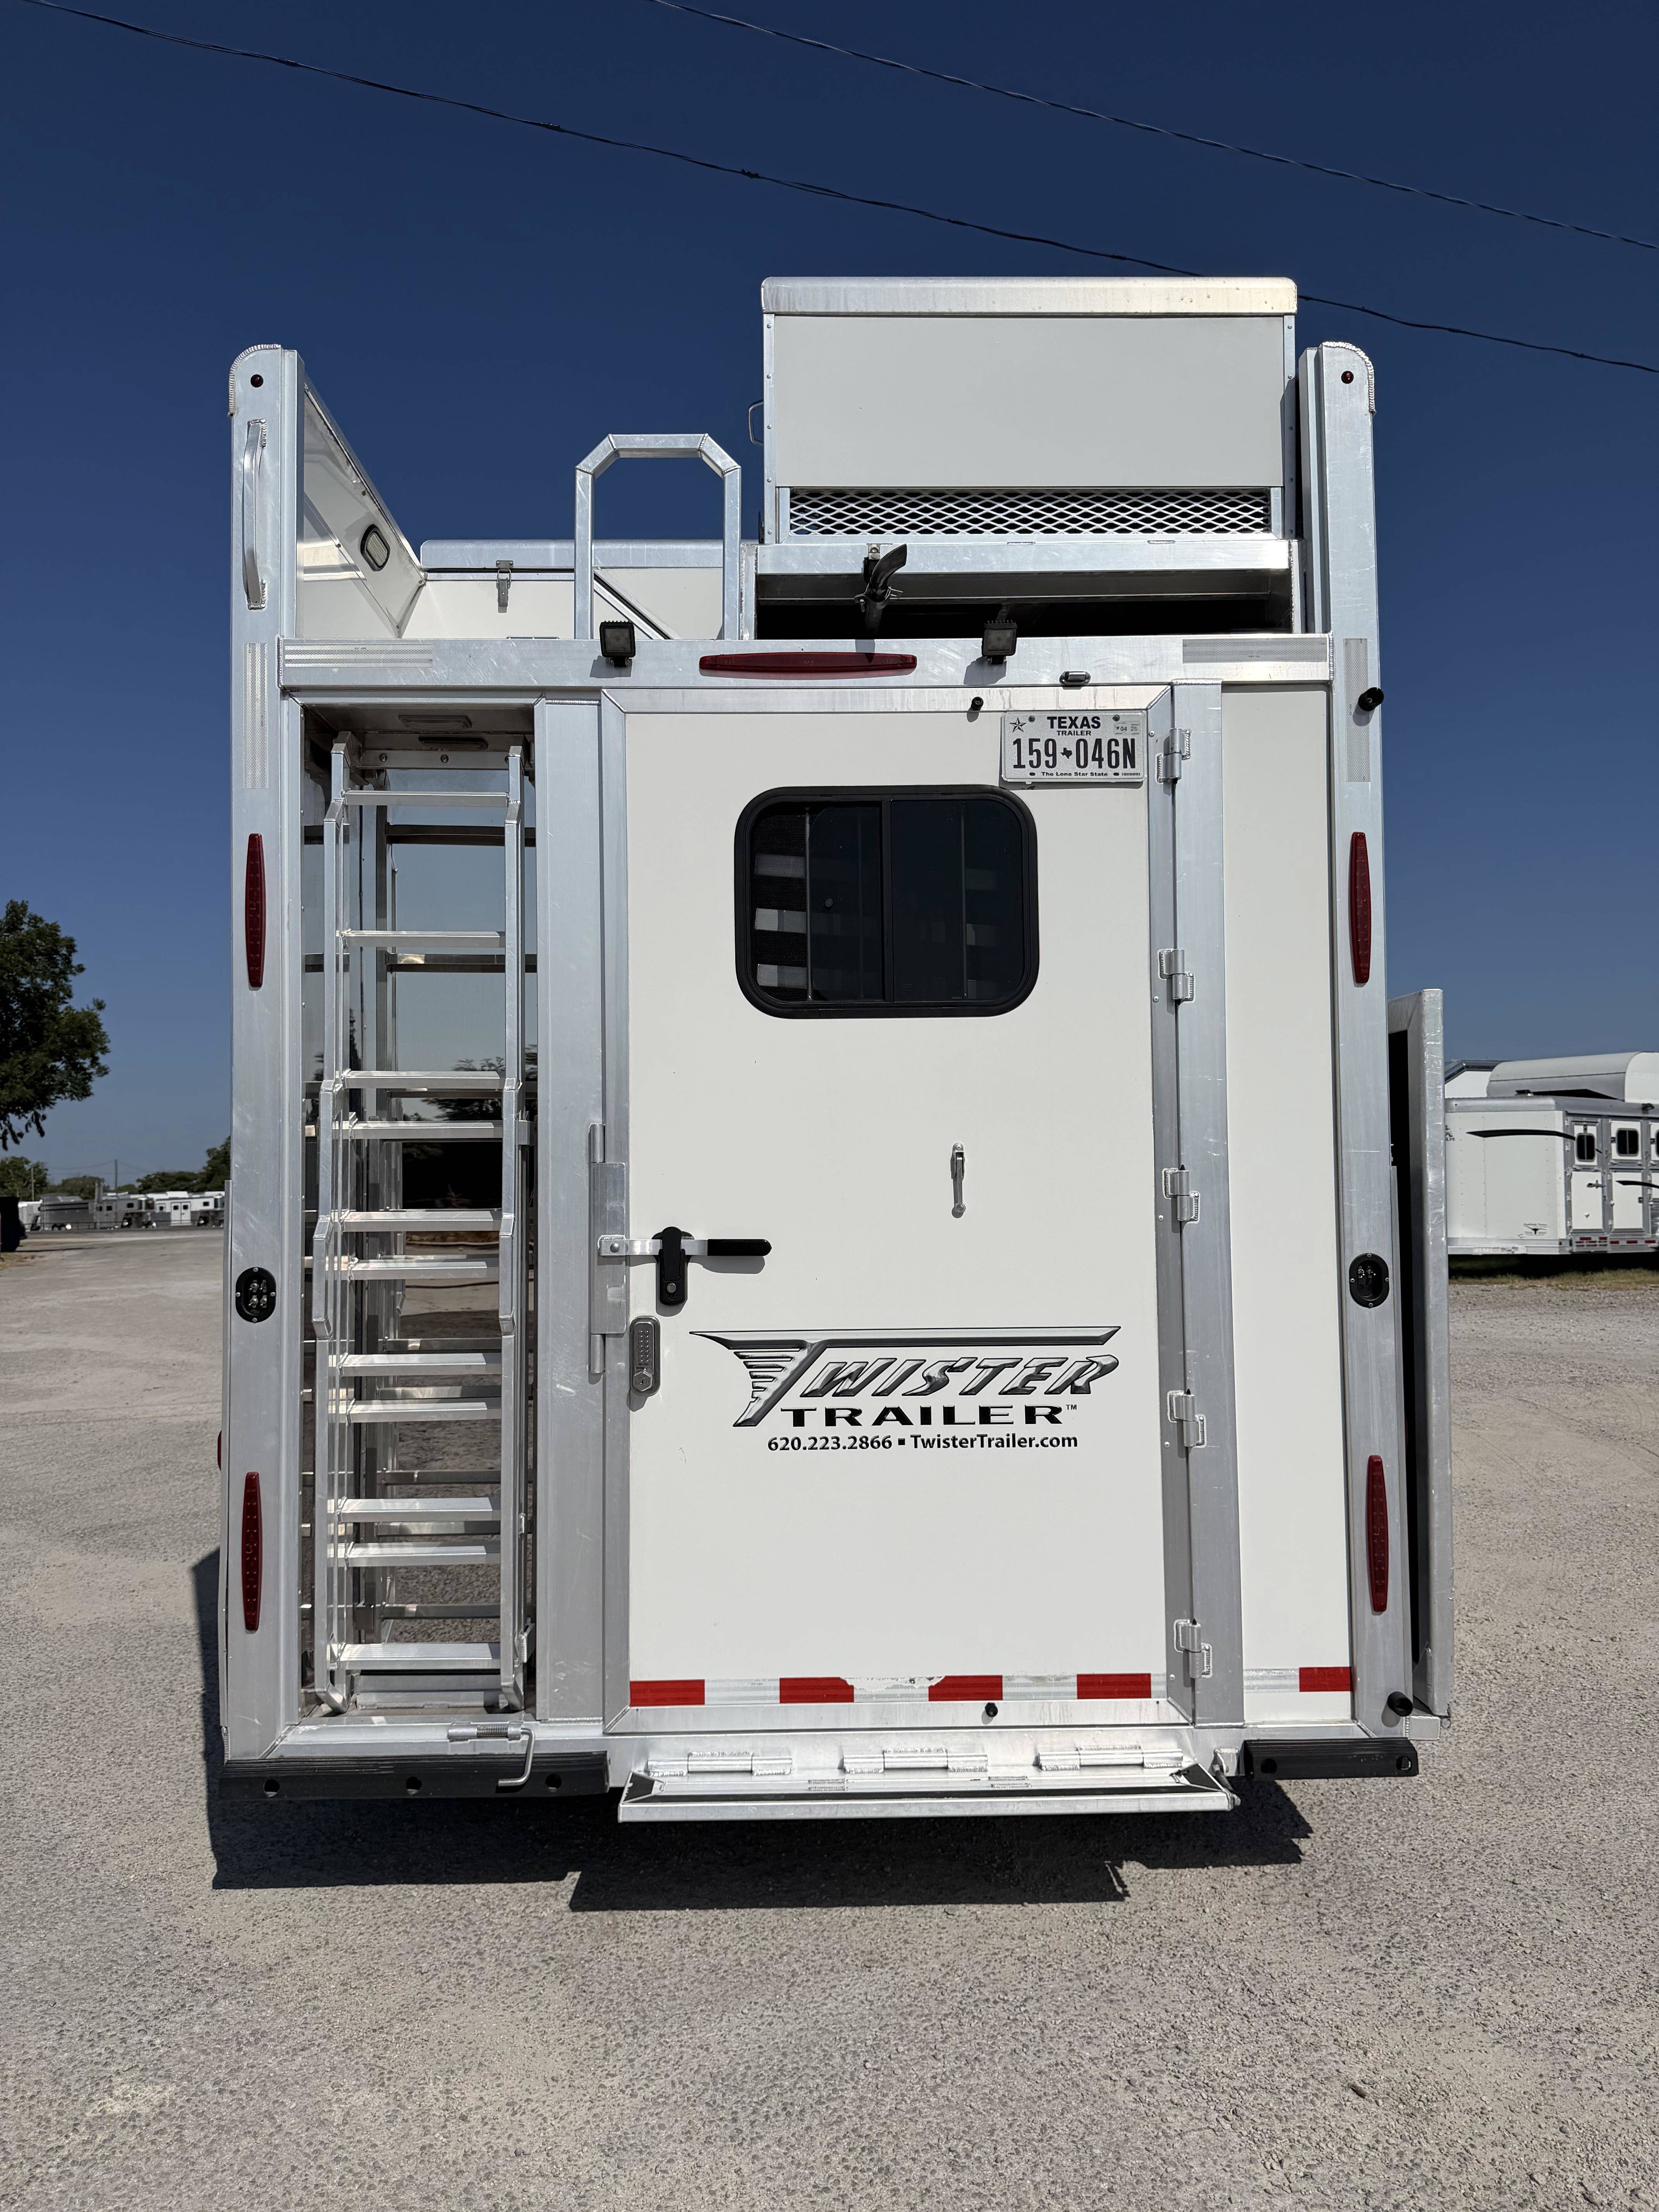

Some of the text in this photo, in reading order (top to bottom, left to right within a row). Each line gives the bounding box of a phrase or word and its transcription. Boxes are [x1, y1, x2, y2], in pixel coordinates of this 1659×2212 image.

[1047, 716, 1101, 729] TEXAS
[1013, 738, 1135, 769] 159 046N
[689, 1326, 1121, 1427] TWISTER
[780, 1404, 1063, 1427] TRAILER
[768, 1433, 1078, 1451] 620.223.2866 TwisterTrailer.com
